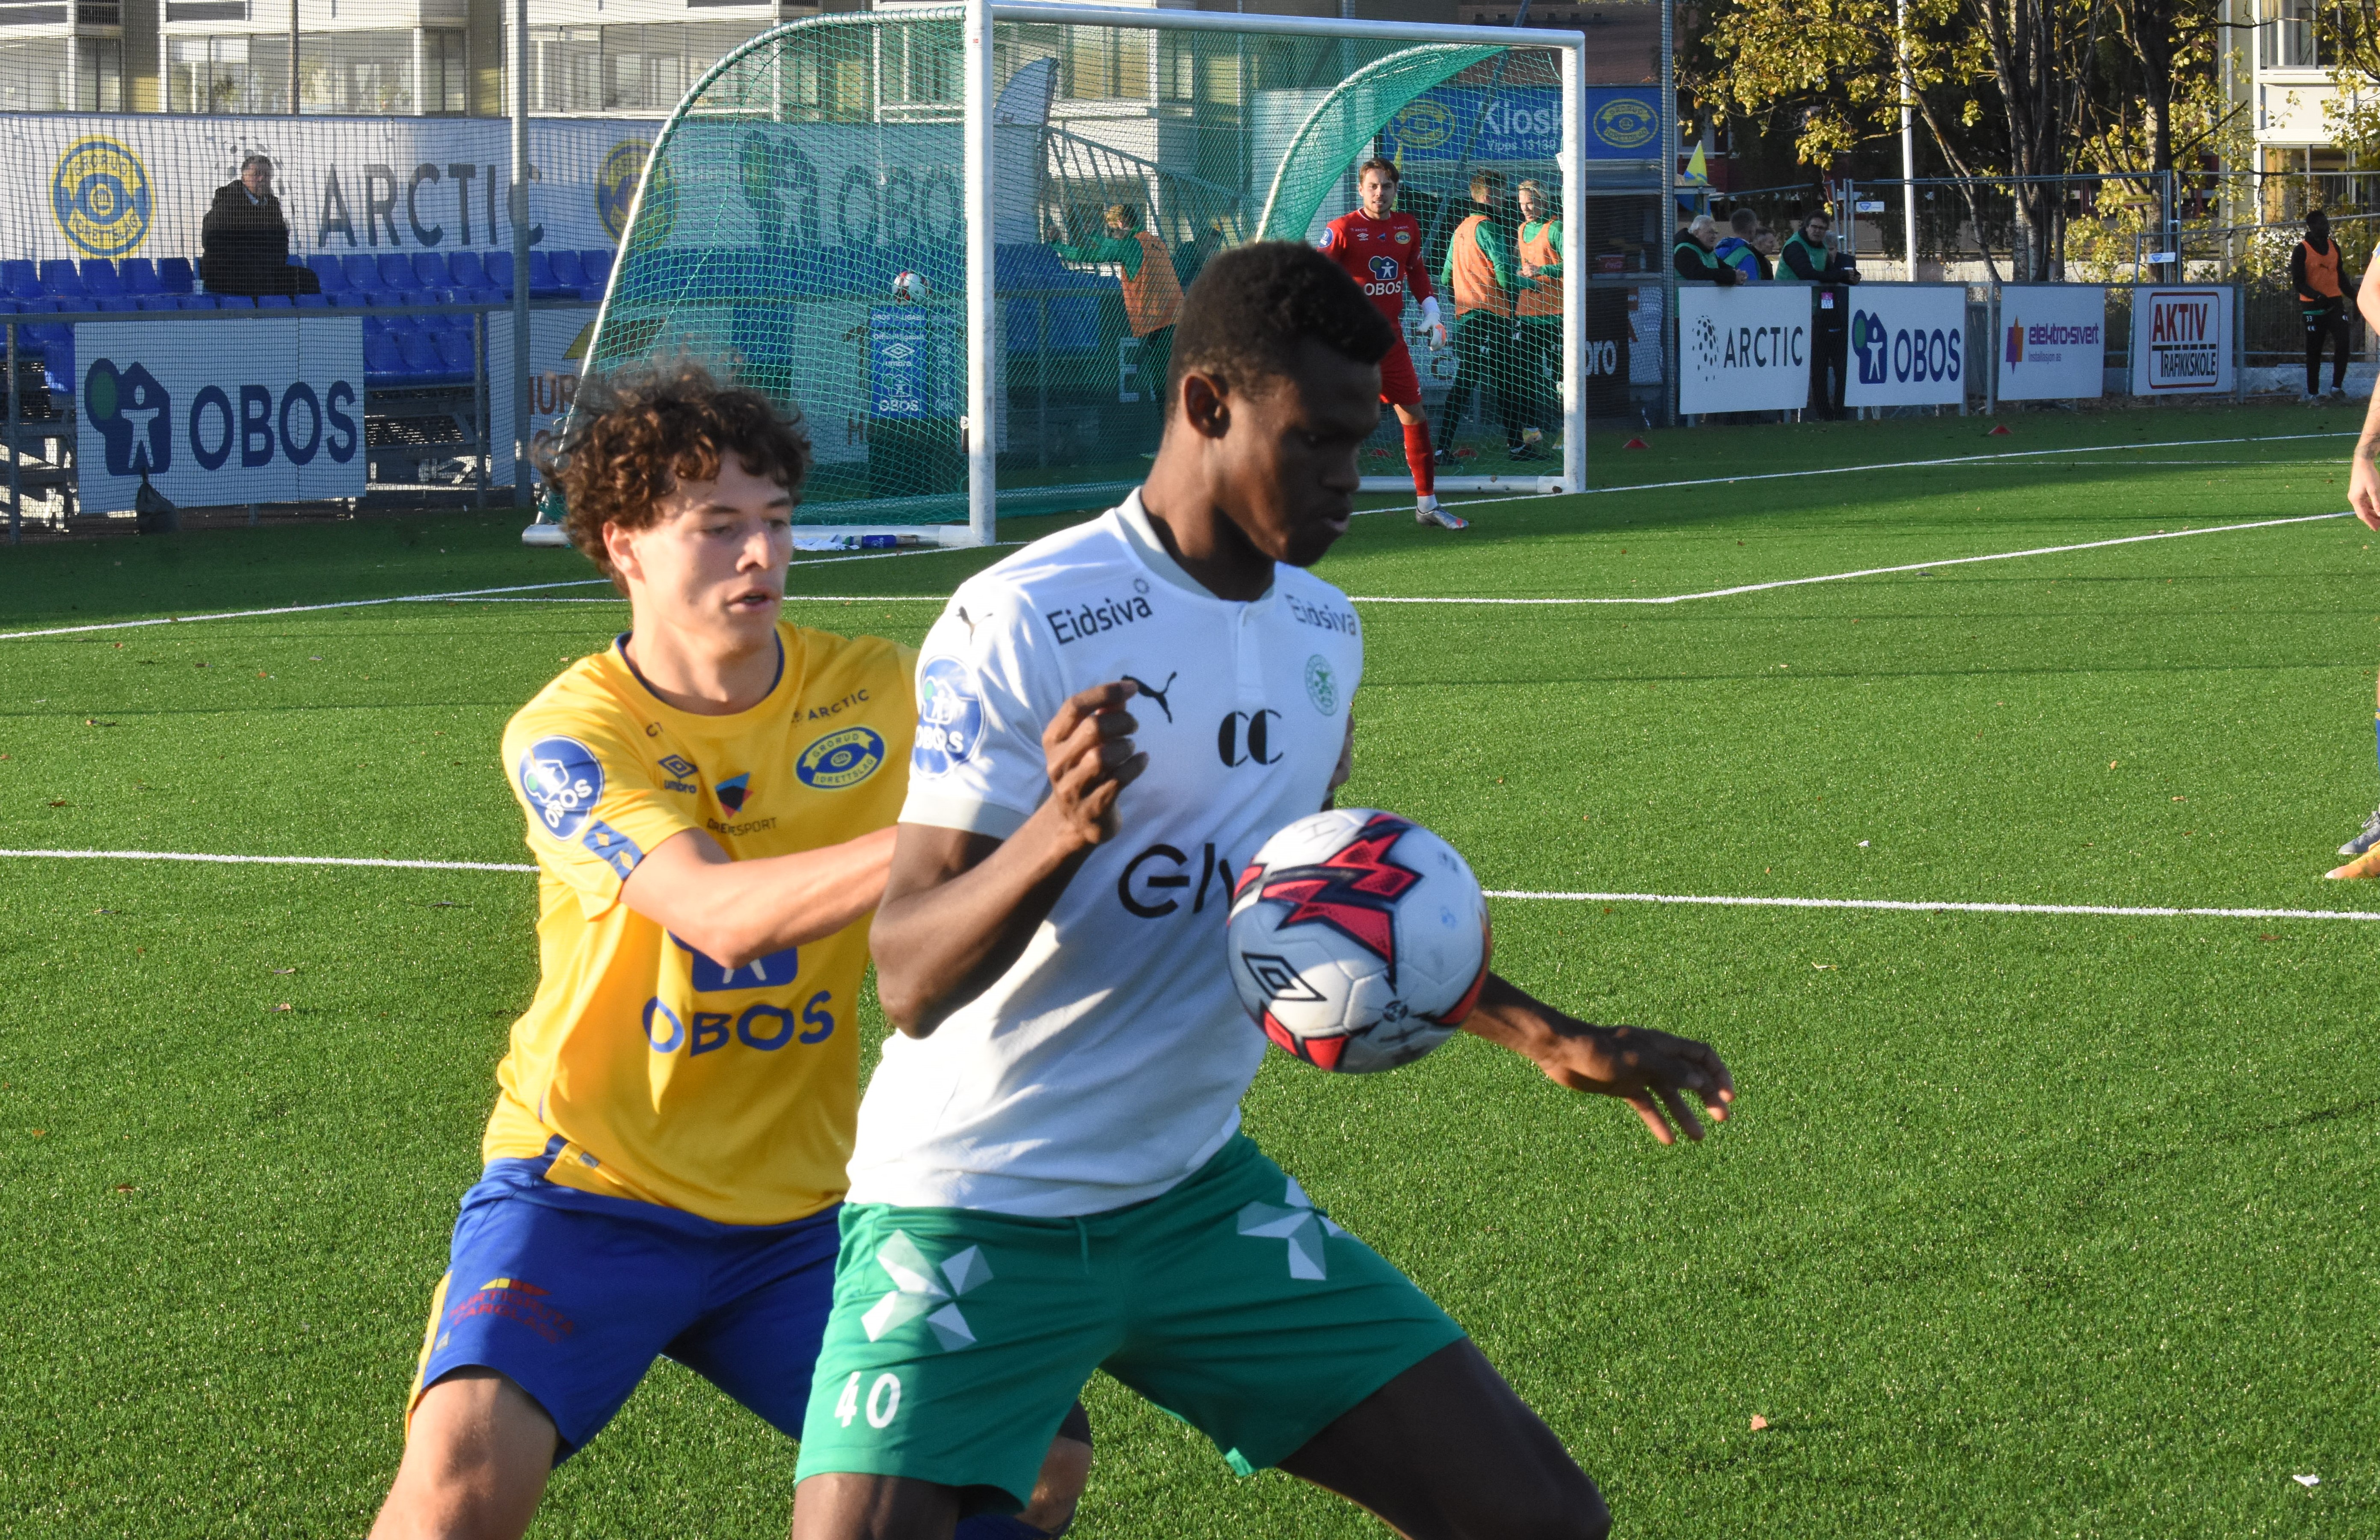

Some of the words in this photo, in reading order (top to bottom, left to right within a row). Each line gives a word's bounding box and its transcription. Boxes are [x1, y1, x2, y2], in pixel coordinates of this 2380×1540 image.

[837, 165, 965, 249] OBO
[1364, 281, 1402, 296] OBOS
[2152, 303, 2208, 342] AKTIV
[1724, 326, 1803, 368] ARCTIC
[1894, 328, 1960, 383] OBOS
[189, 379, 358, 471] OBOS
[879, 400, 919, 412] OBOS
[1046, 596, 1153, 646] Eidsiva
[808, 689, 869, 720] ARCTIC
[812, 733, 859, 758] GRORUD
[915, 725, 963, 753] OBOS
[664, 778, 697, 794] umbro
[816, 758, 874, 783] IDRETTSLAG
[642, 989, 835, 1057] OBOS
[834, 1371, 901, 1428] 40
